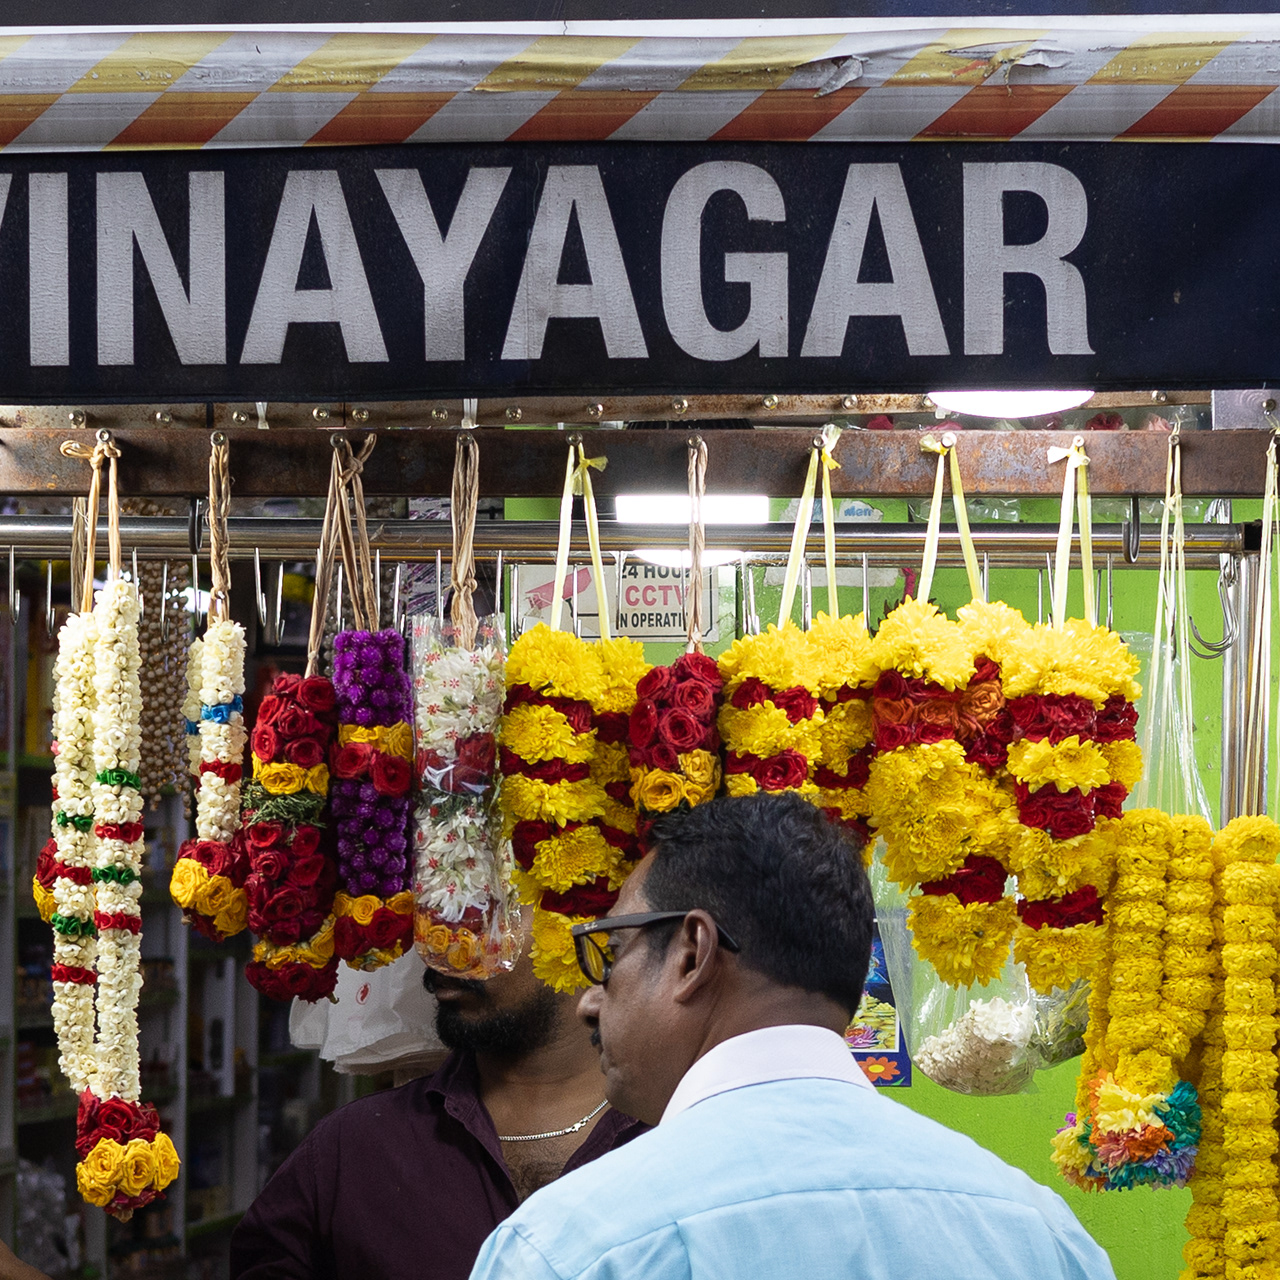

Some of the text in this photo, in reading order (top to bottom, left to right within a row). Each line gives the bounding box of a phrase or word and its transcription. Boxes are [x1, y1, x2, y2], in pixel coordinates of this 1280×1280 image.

[644, 566, 691, 579] HOU
[625, 585, 689, 607] CCTV
[631, 613, 688, 628] OPERATI
